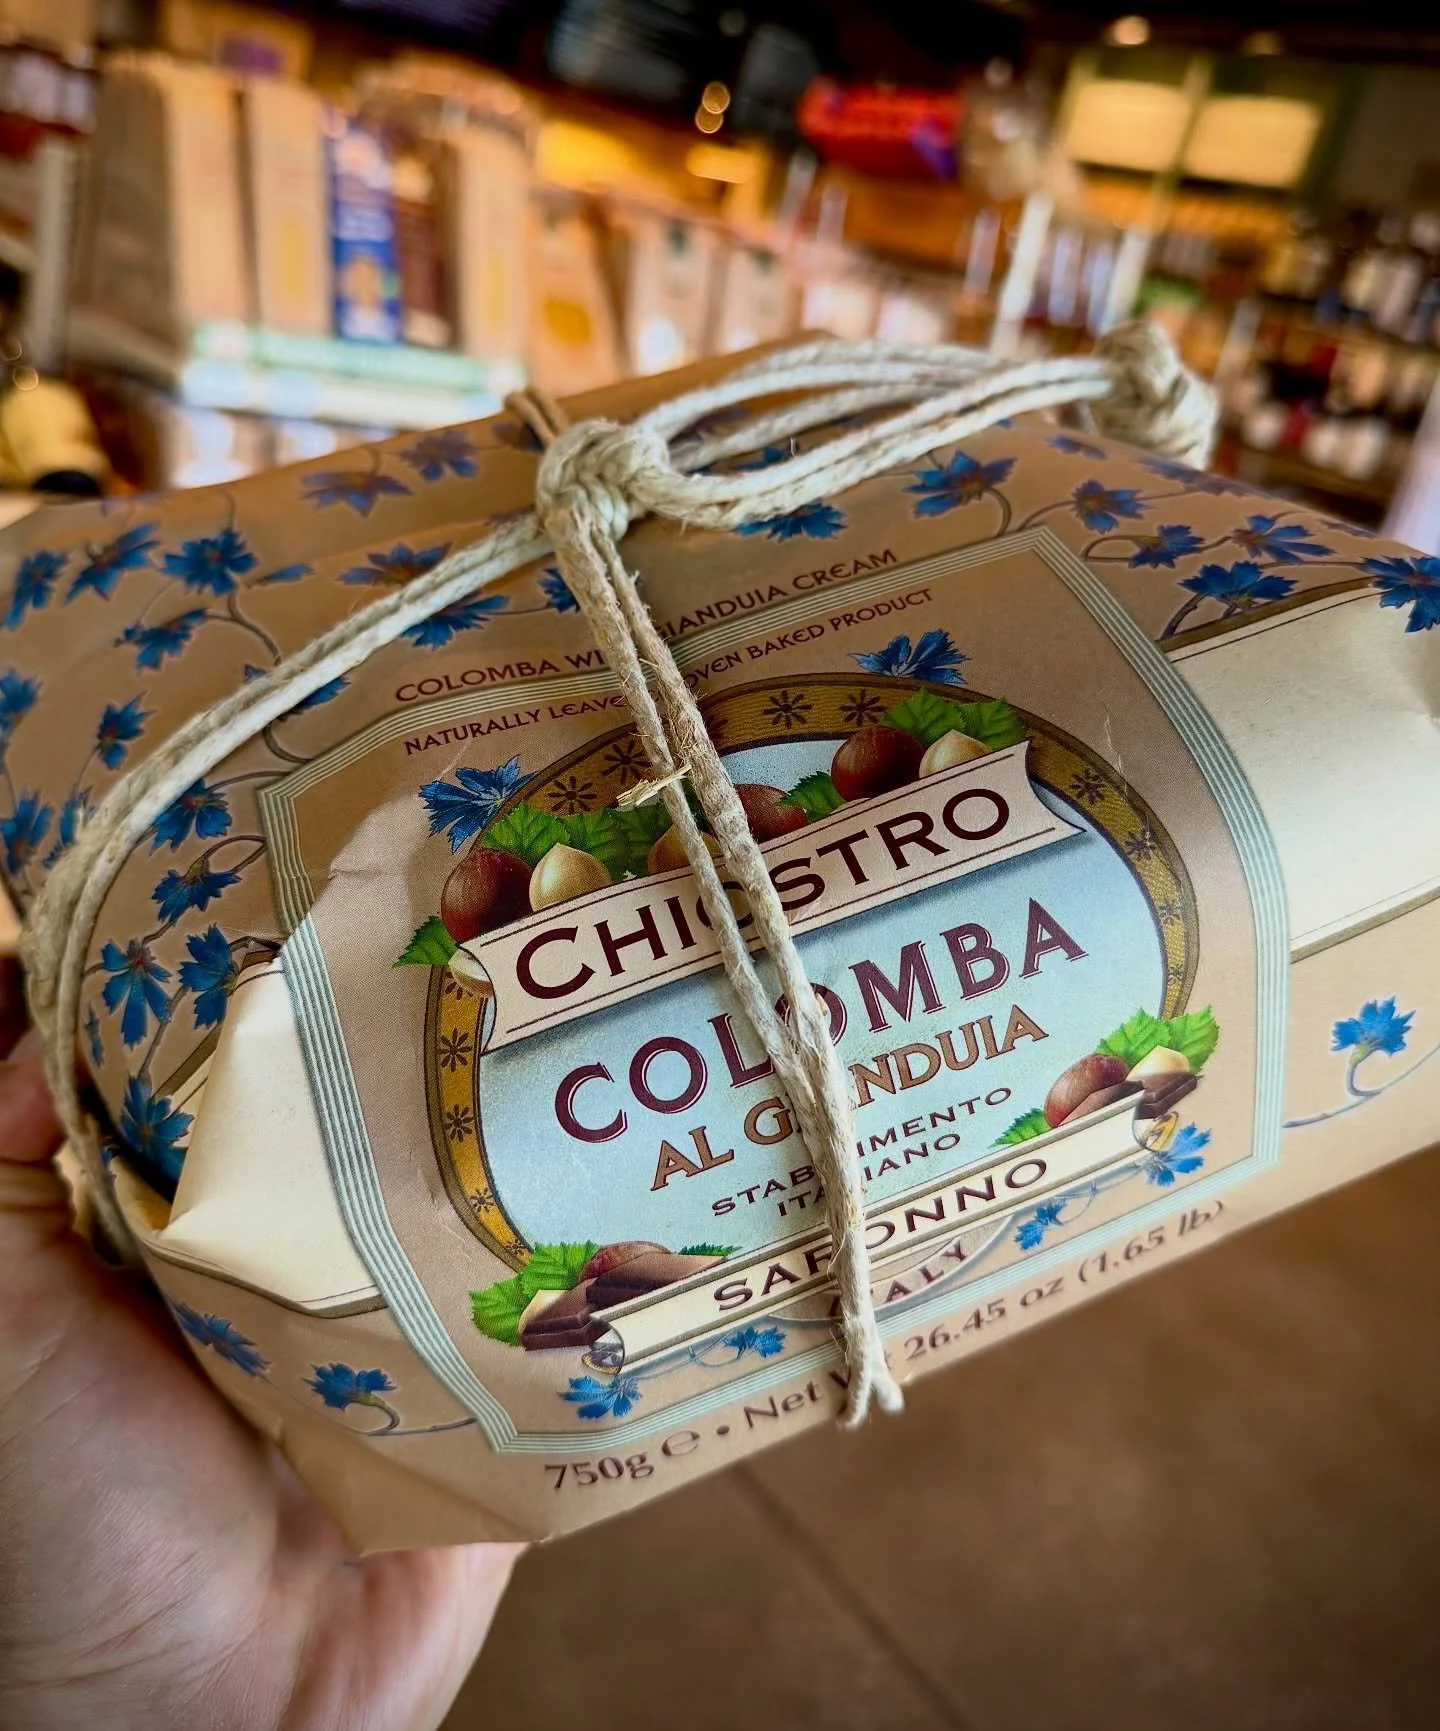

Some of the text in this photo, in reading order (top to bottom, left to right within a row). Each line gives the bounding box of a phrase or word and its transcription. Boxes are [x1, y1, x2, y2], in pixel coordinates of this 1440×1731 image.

[395, 548, 898, 704] COLOMBA WI IANDUIA CREAM
[403, 588, 934, 757] NATURALLY LEAVE OVEN BAKED PRODUCT
[554, 897, 1089, 1144] COLOMBA
[650, 1004, 1050, 1192] AL GNDUIA
[711, 1087, 1012, 1216] STABIMENTO
[777, 1133, 961, 1217] ITIANO
[544, 1451, 655, 1490] 750g
[743, 1379, 824, 1430] Net
[903, 1298, 1006, 1361] 26.45
[1020, 1276, 1065, 1308] oz
[1078, 1225, 1166, 1283] (1.65
[1178, 1199, 1225, 1237] lb)
[827, 1238, 968, 1317] IALY
